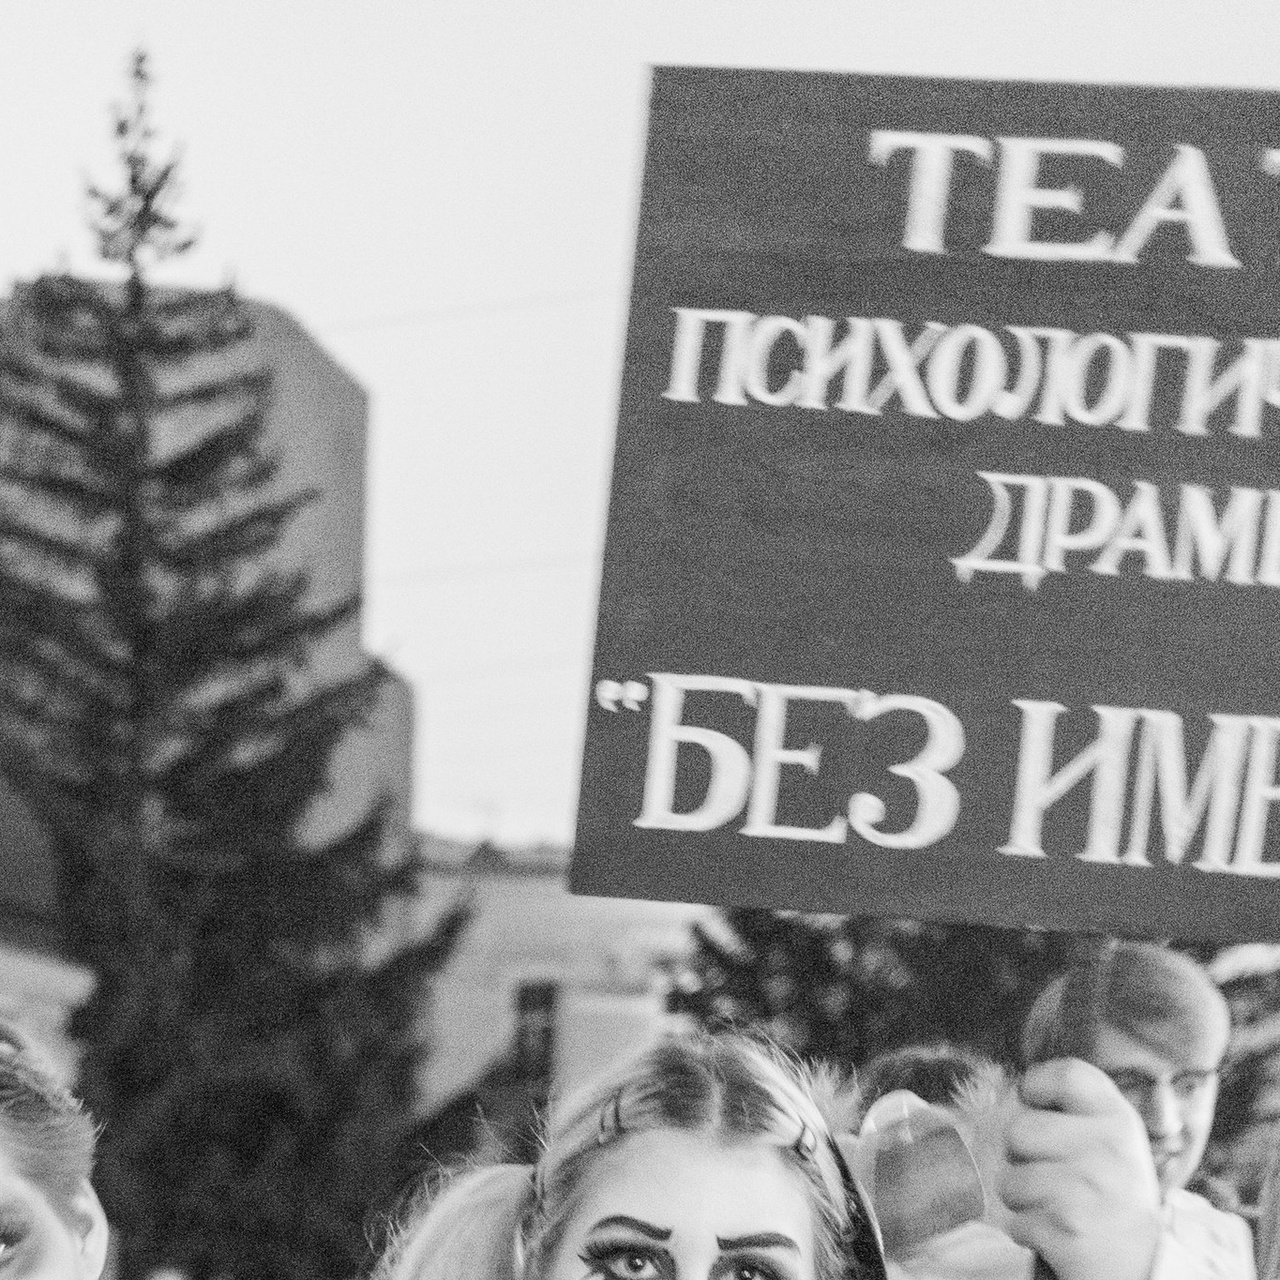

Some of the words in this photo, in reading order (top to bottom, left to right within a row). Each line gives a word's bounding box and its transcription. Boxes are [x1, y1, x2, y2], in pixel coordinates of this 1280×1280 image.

[870, 128, 1280, 269] ТЕА
[663, 306, 1280, 438] ПСИХОЛОГИ
[951, 471, 1280, 590] ДРАМ
